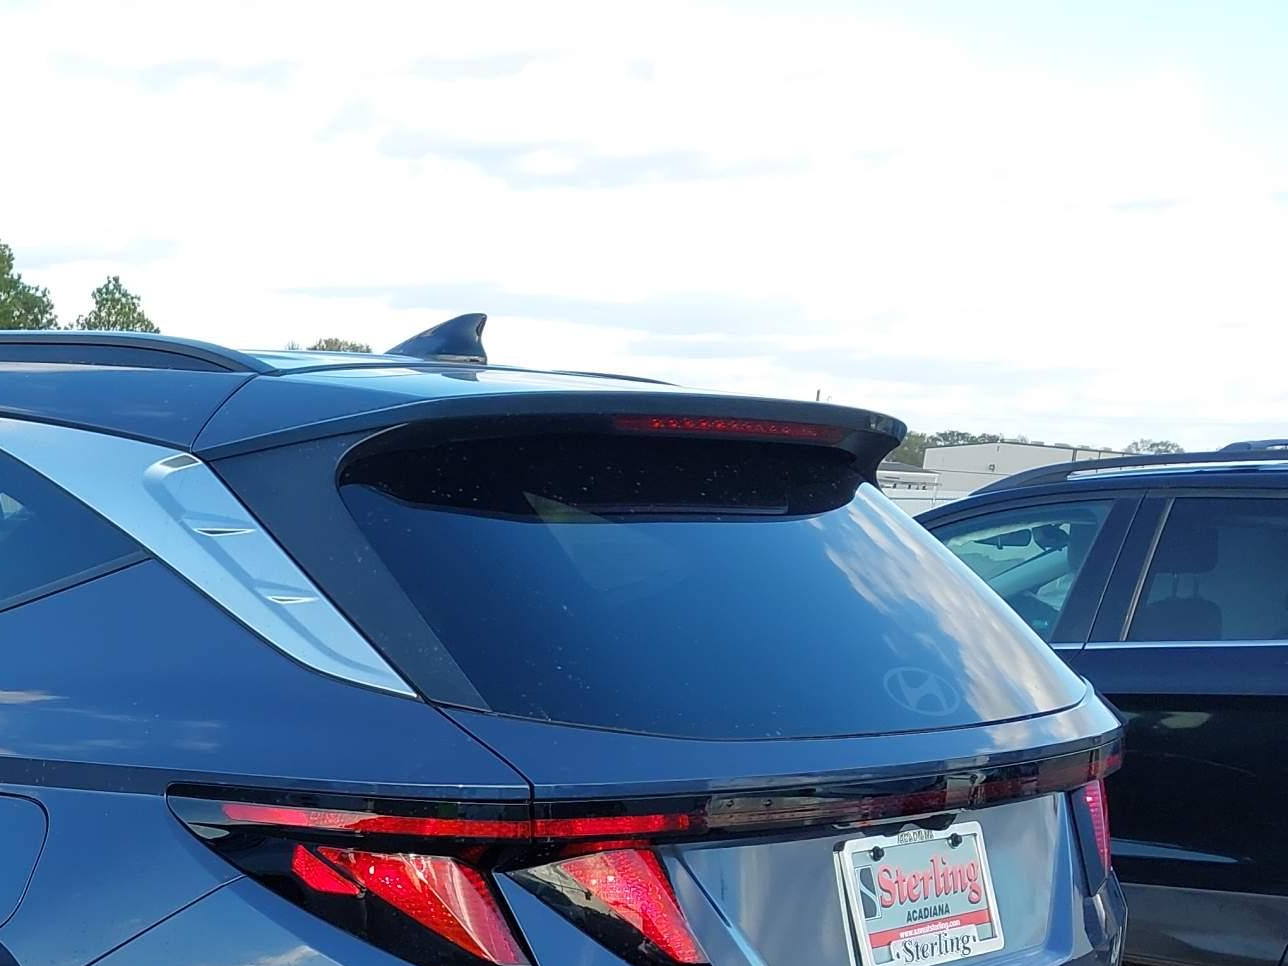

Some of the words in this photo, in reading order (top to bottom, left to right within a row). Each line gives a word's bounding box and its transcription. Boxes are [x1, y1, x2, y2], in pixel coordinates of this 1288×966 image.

[878, 854, 982, 909] Sterling
[907, 903, 951, 923] ACADIANA
[900, 932, 973, 964] Sterling
